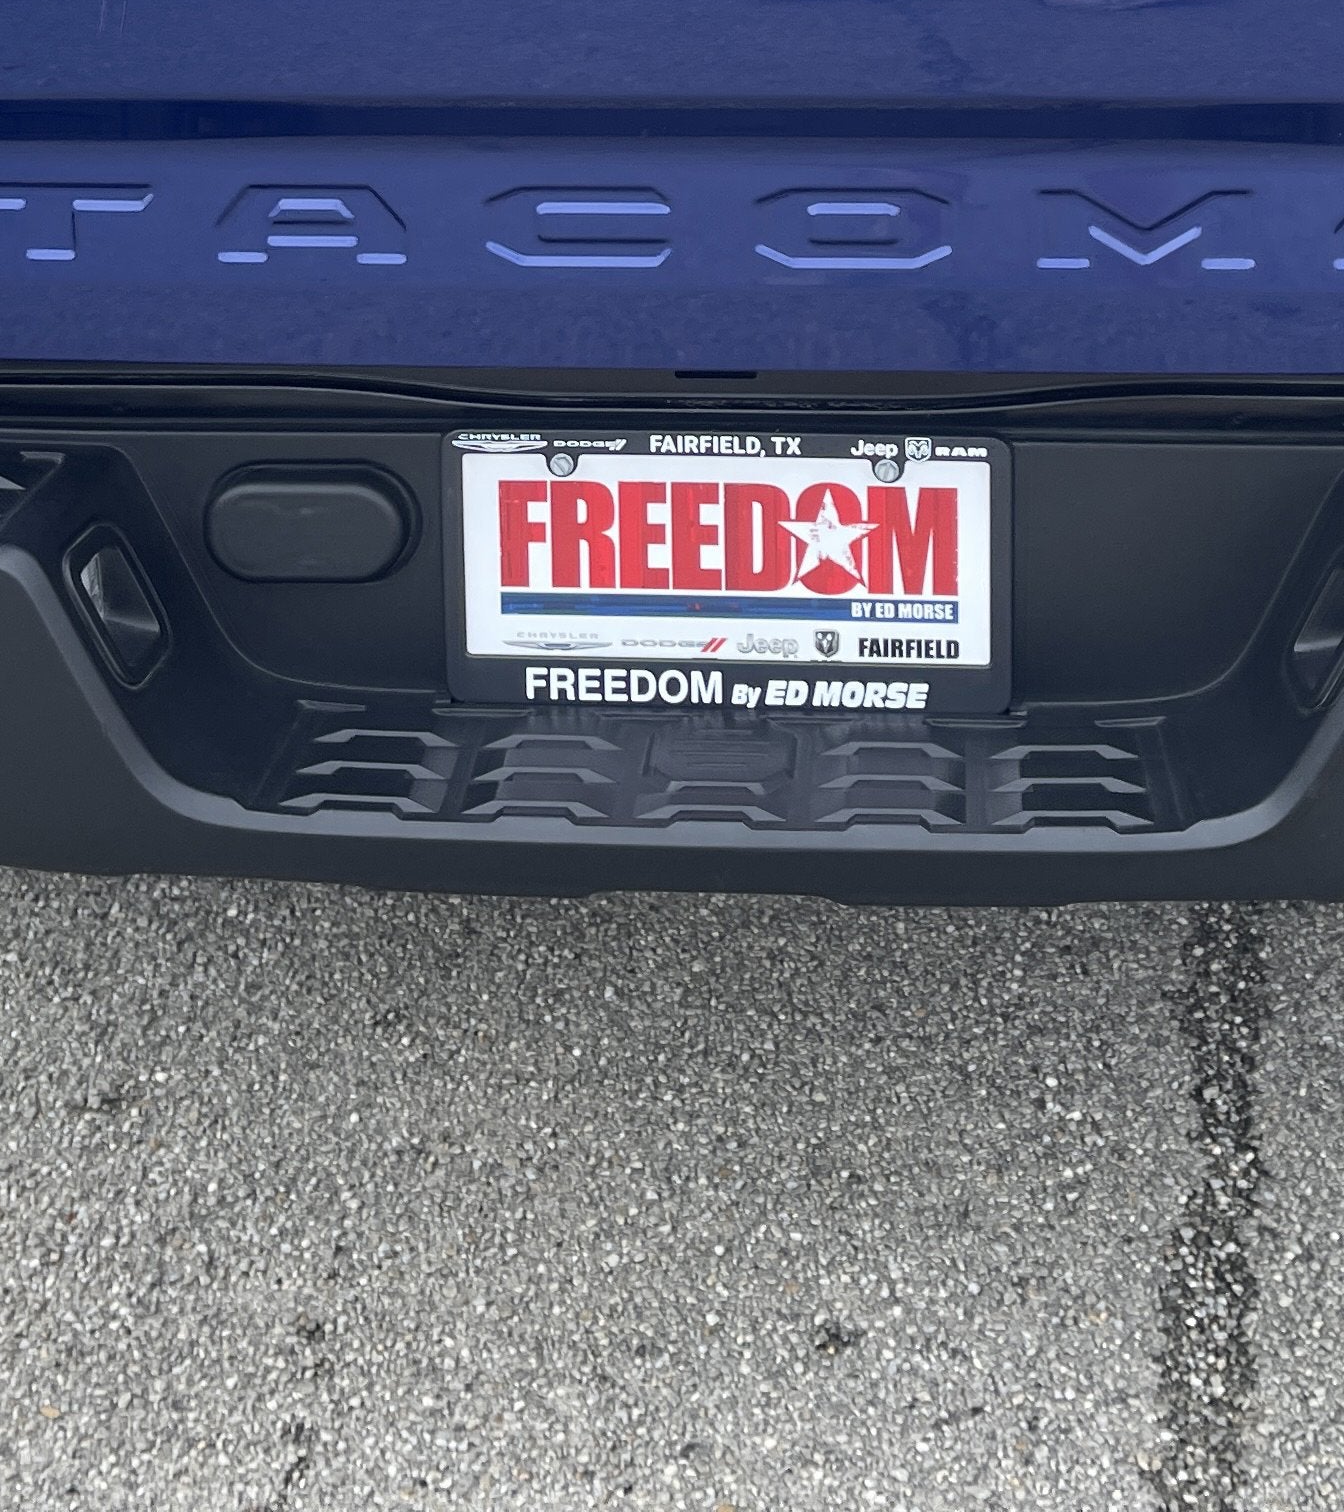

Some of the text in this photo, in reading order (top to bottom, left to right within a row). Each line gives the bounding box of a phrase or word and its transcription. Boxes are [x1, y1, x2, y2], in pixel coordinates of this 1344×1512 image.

[457, 433, 541, 441] CHRYSLER
[649, 434, 802, 458] FAIRFIELD, TX
[850, 439, 899, 458] Jeep
[934, 446, 988, 457] RAM
[498, 479, 958, 597] FREEDOM
[851, 601, 954, 621] BY ED MORSE
[516, 631, 599, 639] CHRYSLER
[621, 639, 708, 648] DODGE
[737, 633, 799, 658] Jeep
[858, 637, 960, 659] FAIRFIELD
[524, 666, 930, 710] FREEDOM By ED MORSE
